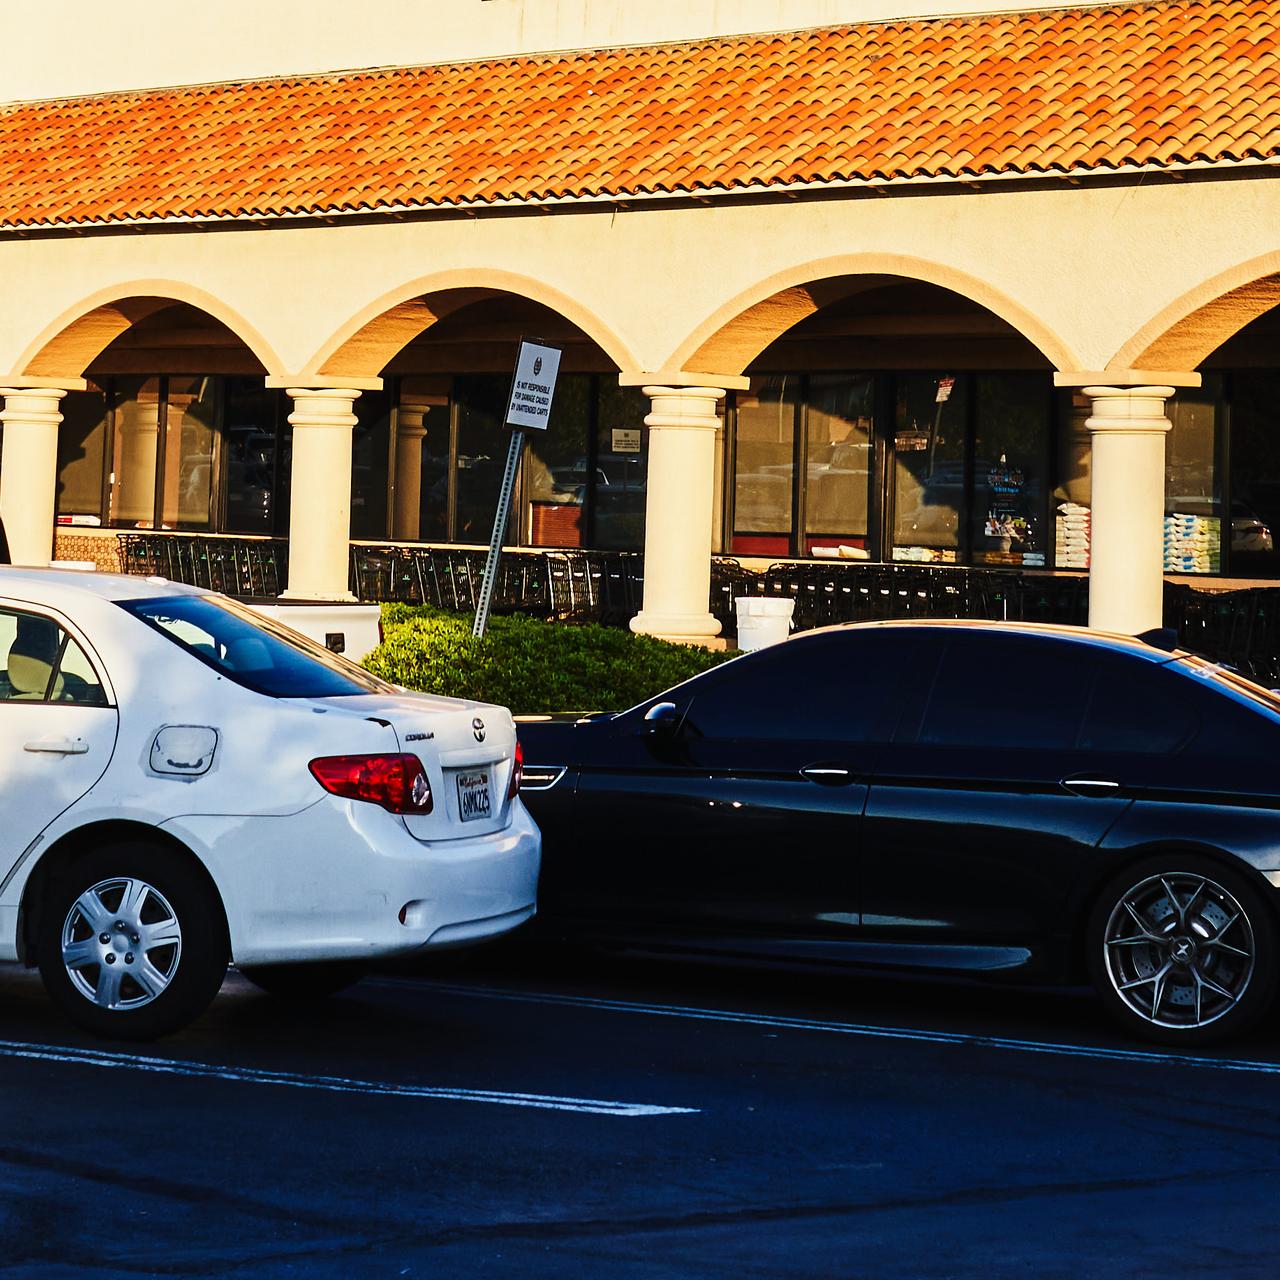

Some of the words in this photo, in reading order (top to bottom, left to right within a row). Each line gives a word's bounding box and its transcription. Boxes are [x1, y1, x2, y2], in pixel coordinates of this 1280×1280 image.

[528, 382, 550, 394] RESPONSIBLE
[537, 407, 548, 416] CARTS
[405, 732, 434, 741] COROLLA
